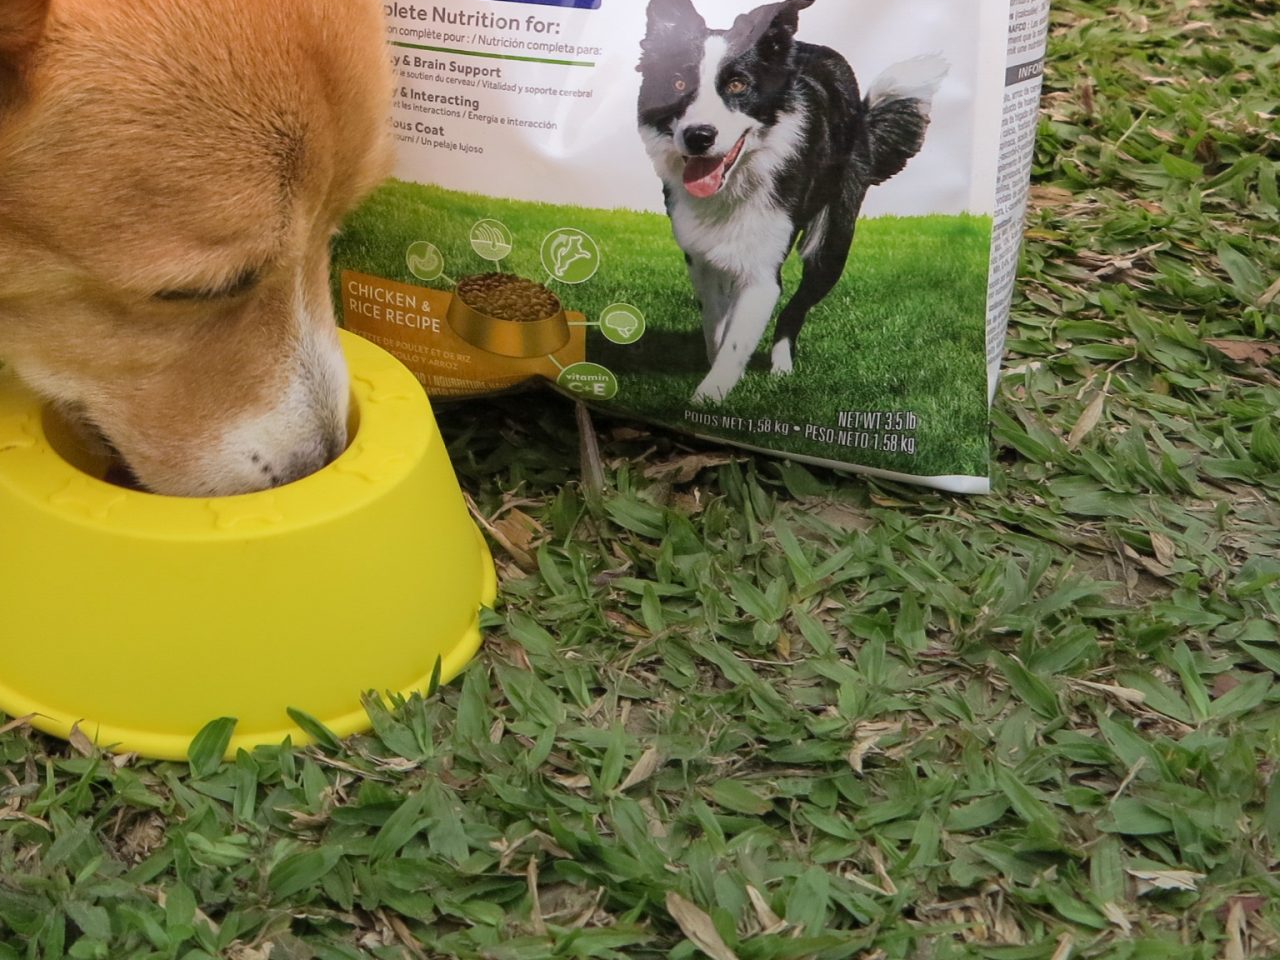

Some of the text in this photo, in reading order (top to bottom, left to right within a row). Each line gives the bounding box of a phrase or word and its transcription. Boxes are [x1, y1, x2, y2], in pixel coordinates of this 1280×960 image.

[384, 2, 560, 35] plete Nutrition for:
[399, 26, 442, 40] complète
[443, 33, 465, 43] pour
[479, 35, 525, 49] Nutrición
[526, 41, 575, 54] completa
[576, 45, 602, 56] para:
[403, 55, 410, 66] &
[414, 56, 446, 71] Brain
[449, 61, 501, 78] Support
[407, 71, 433, 81] soutien
[435, 74, 444, 83] du
[445, 76, 475, 87] cerveau
[482, 80, 517, 92] Vitalidad
[517, 86, 523, 94] y
[524, 86, 560, 96] soporte
[560, 89, 593, 98] cerebral
[400, 87, 408, 98] &
[410, 88, 479, 111] Interacting
[402, 100, 411, 110] les
[413, 104, 460, 118] interactions
[507, 117, 557, 130] interacción
[415, 122, 444, 136] Coat
[348, 281, 431, 312] CHICKEN &
[349, 298, 440, 333] RICE RECIPE
[565, 372, 609, 381] vitamin
[684, 410, 915, 454] POIDS NET 1.58 kg PESO NETO 1.58 kg
[838, 411, 916, 430] NET WT 3.5 lb
